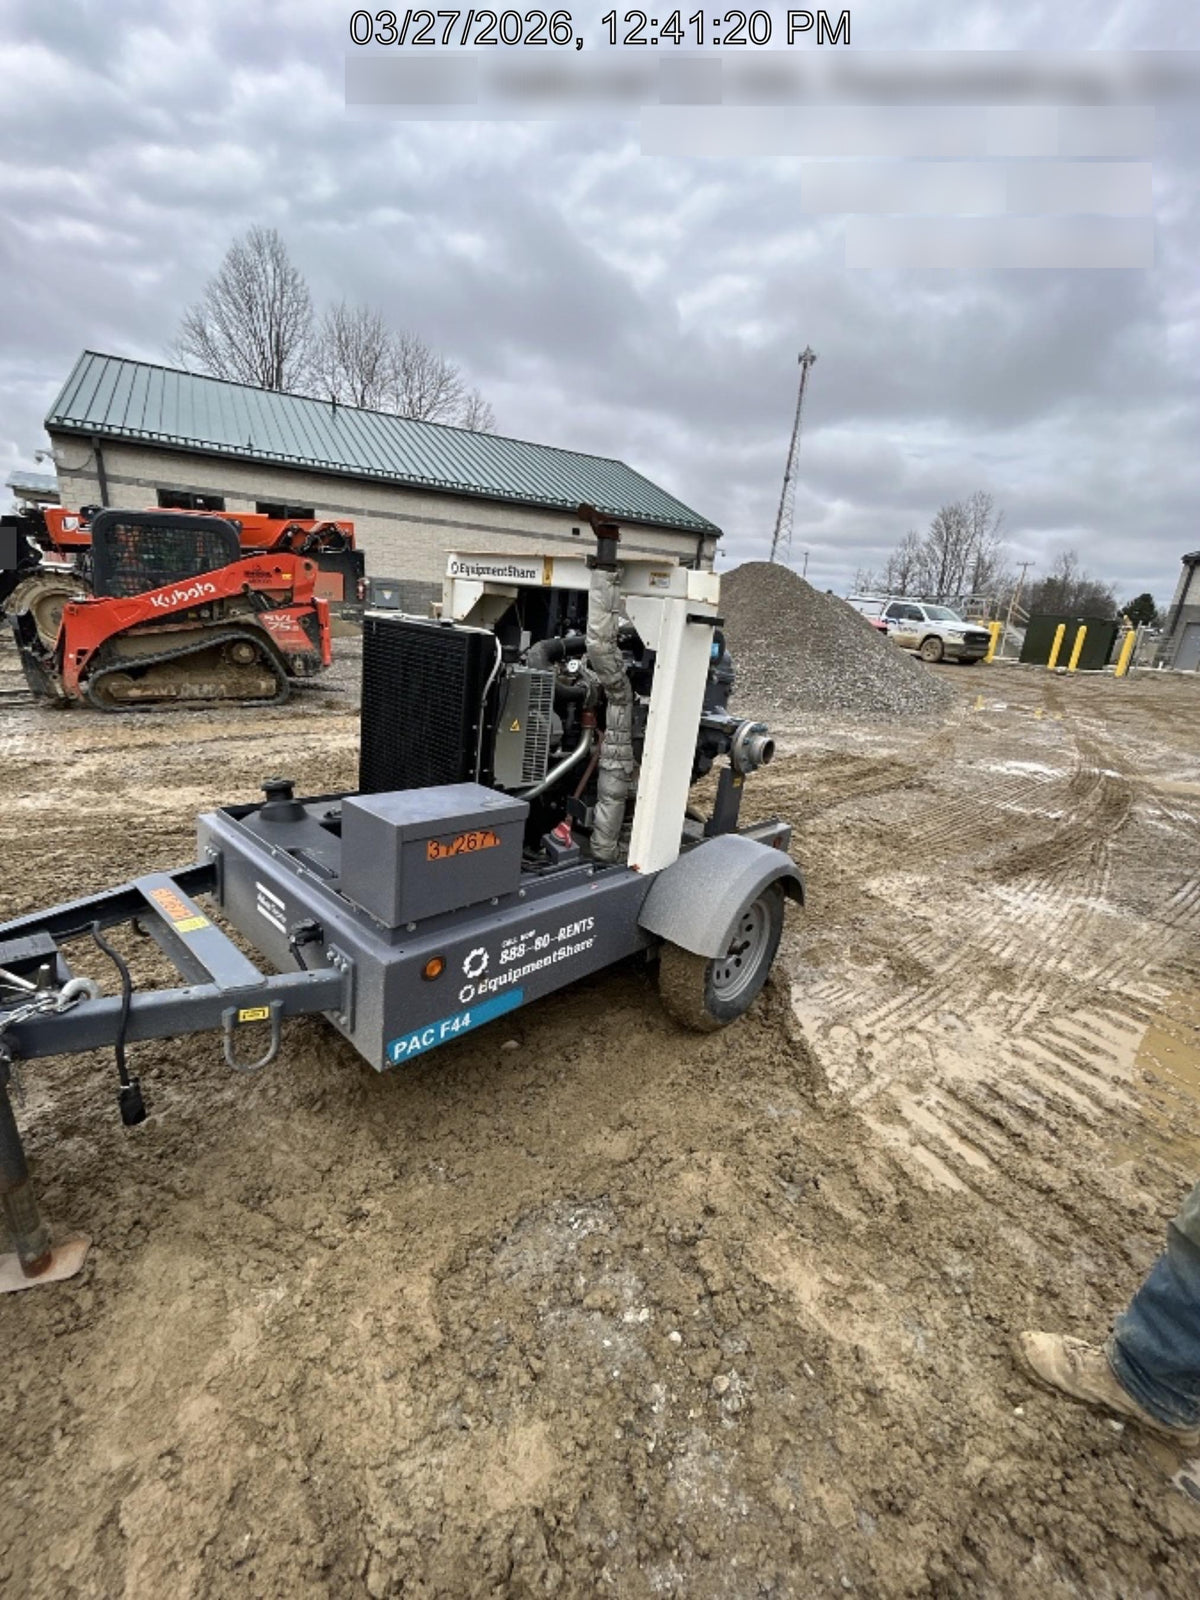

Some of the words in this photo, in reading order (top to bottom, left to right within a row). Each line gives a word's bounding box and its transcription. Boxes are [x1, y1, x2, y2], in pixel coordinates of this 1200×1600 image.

[460, 563, 536, 579] EquipmentShare
[150, 582, 216, 607] Kubota
[478, 938, 594, 995] EquipmentShare
[393, 1028, 435, 1060] PAC
[440, 1012, 471, 1039] F44
